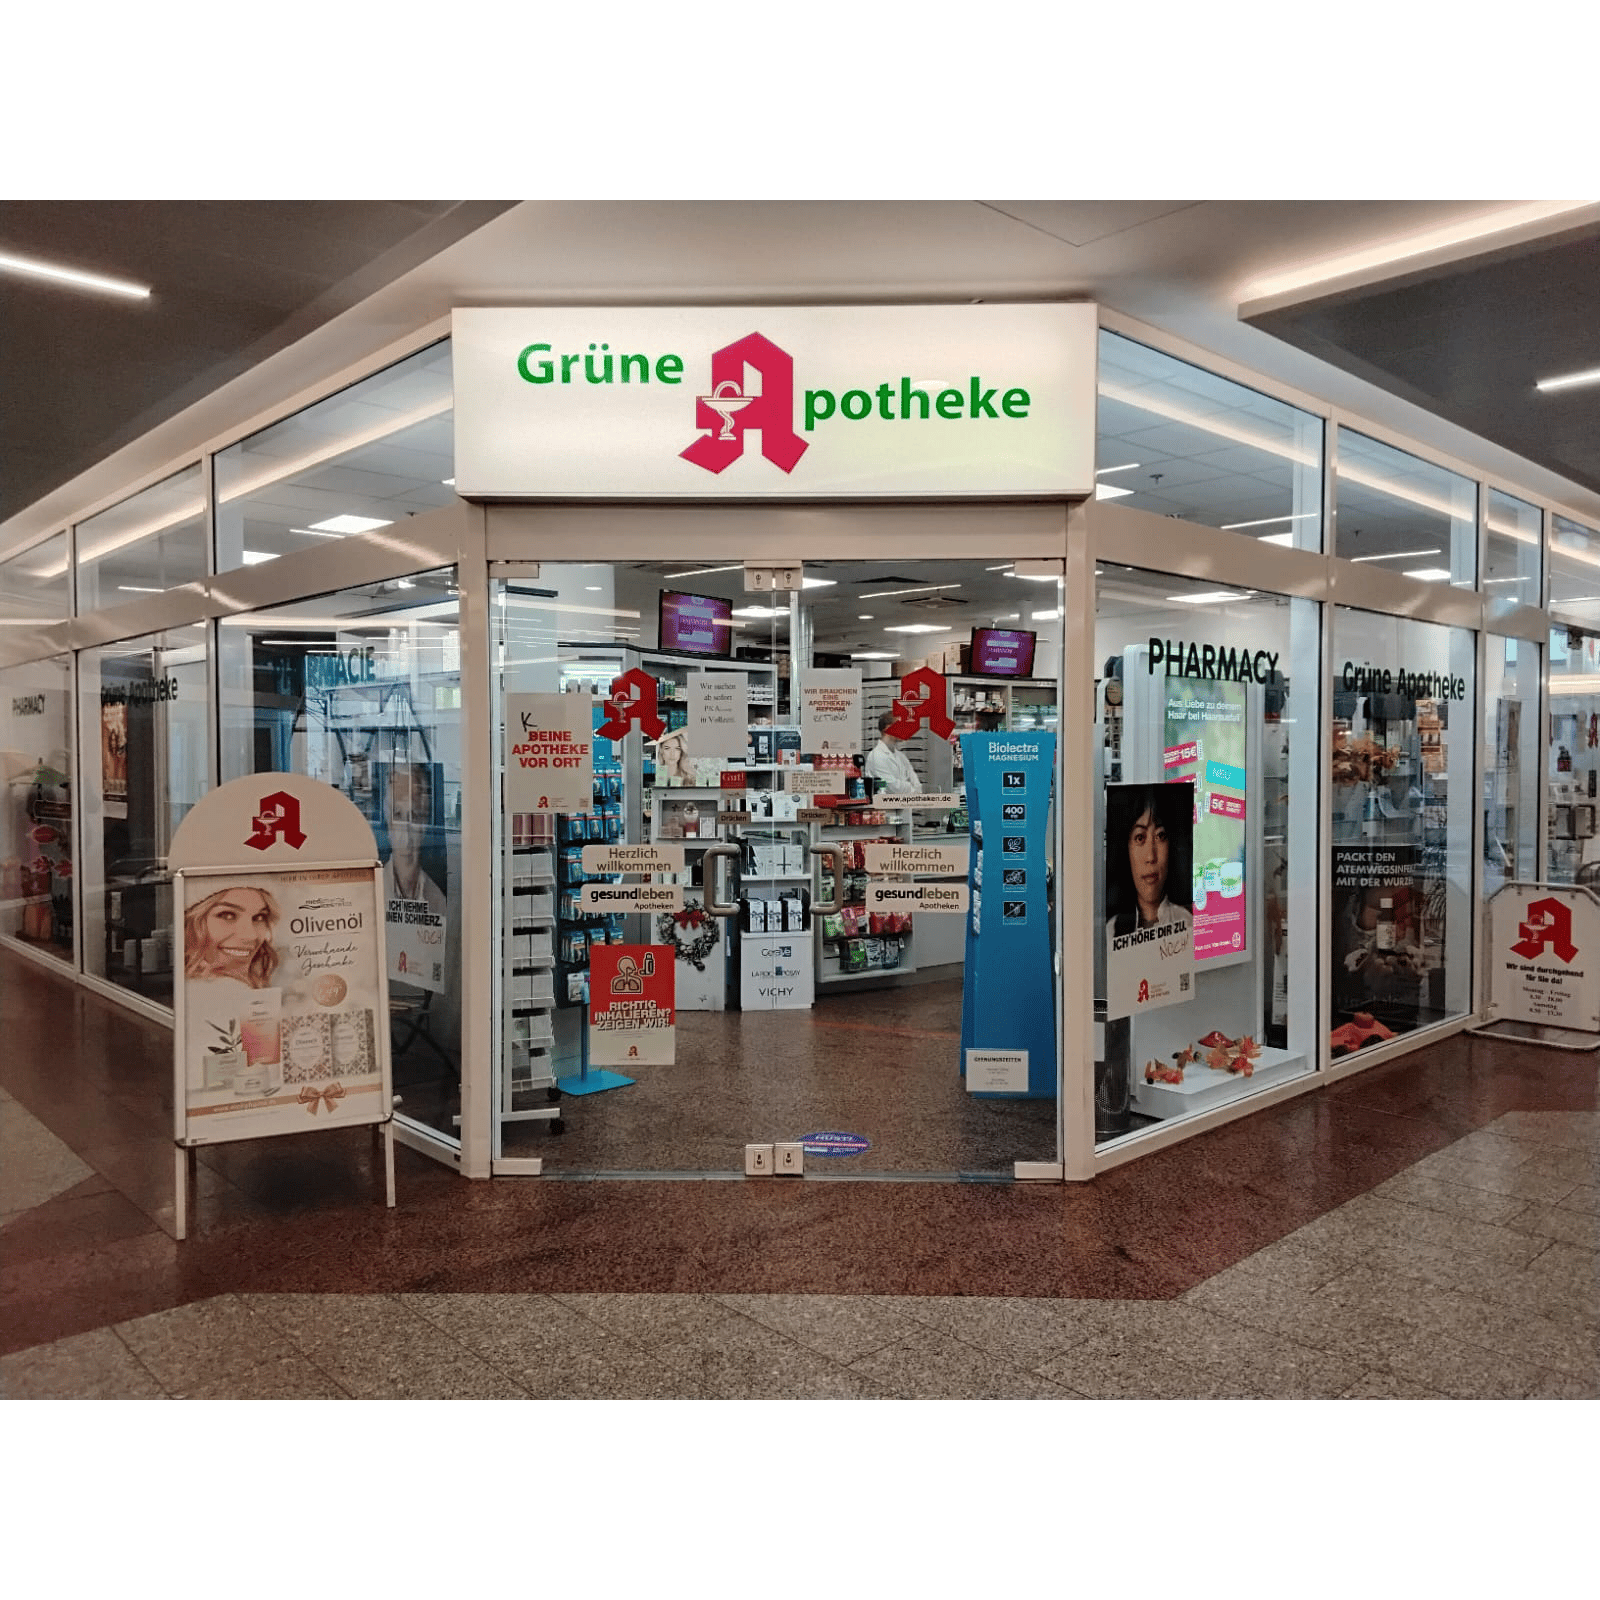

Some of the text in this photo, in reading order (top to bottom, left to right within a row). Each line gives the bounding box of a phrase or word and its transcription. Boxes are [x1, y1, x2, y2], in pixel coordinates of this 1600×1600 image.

[517, 343, 685, 385] Grüne
[1149, 637, 1279, 685] PHARMACY
[1343, 661, 1465, 701] Grüne Apotheke
[521, 711, 538, 732] K
[512, 744, 589, 755] APOTHEKE
[988, 742, 1039, 753] Biolectra
[519, 757, 582, 768] VOR ORT
[1007, 774, 1020, 785] 1x
[609, 847, 658, 859] Herzlich
[892, 848, 941, 859] Herzlich
[1336, 852, 1396, 861] PACKT DEN
[597, 860, 671, 872] willkommen
[880, 860, 955, 872] willkommen
[1336, 877, 1357, 887] MIT
[1360, 877, 1381, 887] DER
[590, 888, 674, 902] gesundleben
[875, 887, 960, 901] gesundleben
[389, 900, 402, 911] ICH
[634, 902, 674, 910] Apotheken
[919, 902, 960, 910] Apotheken
[290, 912, 363, 934] Olivenöl
[1112, 936, 1129, 951] ICH
[1131, 929, 1155, 946] HÖRE
[1157, 924, 1172, 939] DIR
[1174, 920, 1186, 935] ZU.
[1506, 962, 1584, 978] Wir sind durchgehend
[1537, 975, 1549, 983] Sie
[1550, 977, 1563, 985] da!
[758, 987, 793, 996] VICHY
[609, 1000, 657, 1011] RICHTIG
[594, 1008, 672, 1021] INHALIEREN?
[597, 1017, 670, 1031] ZEIGEN WIR!
